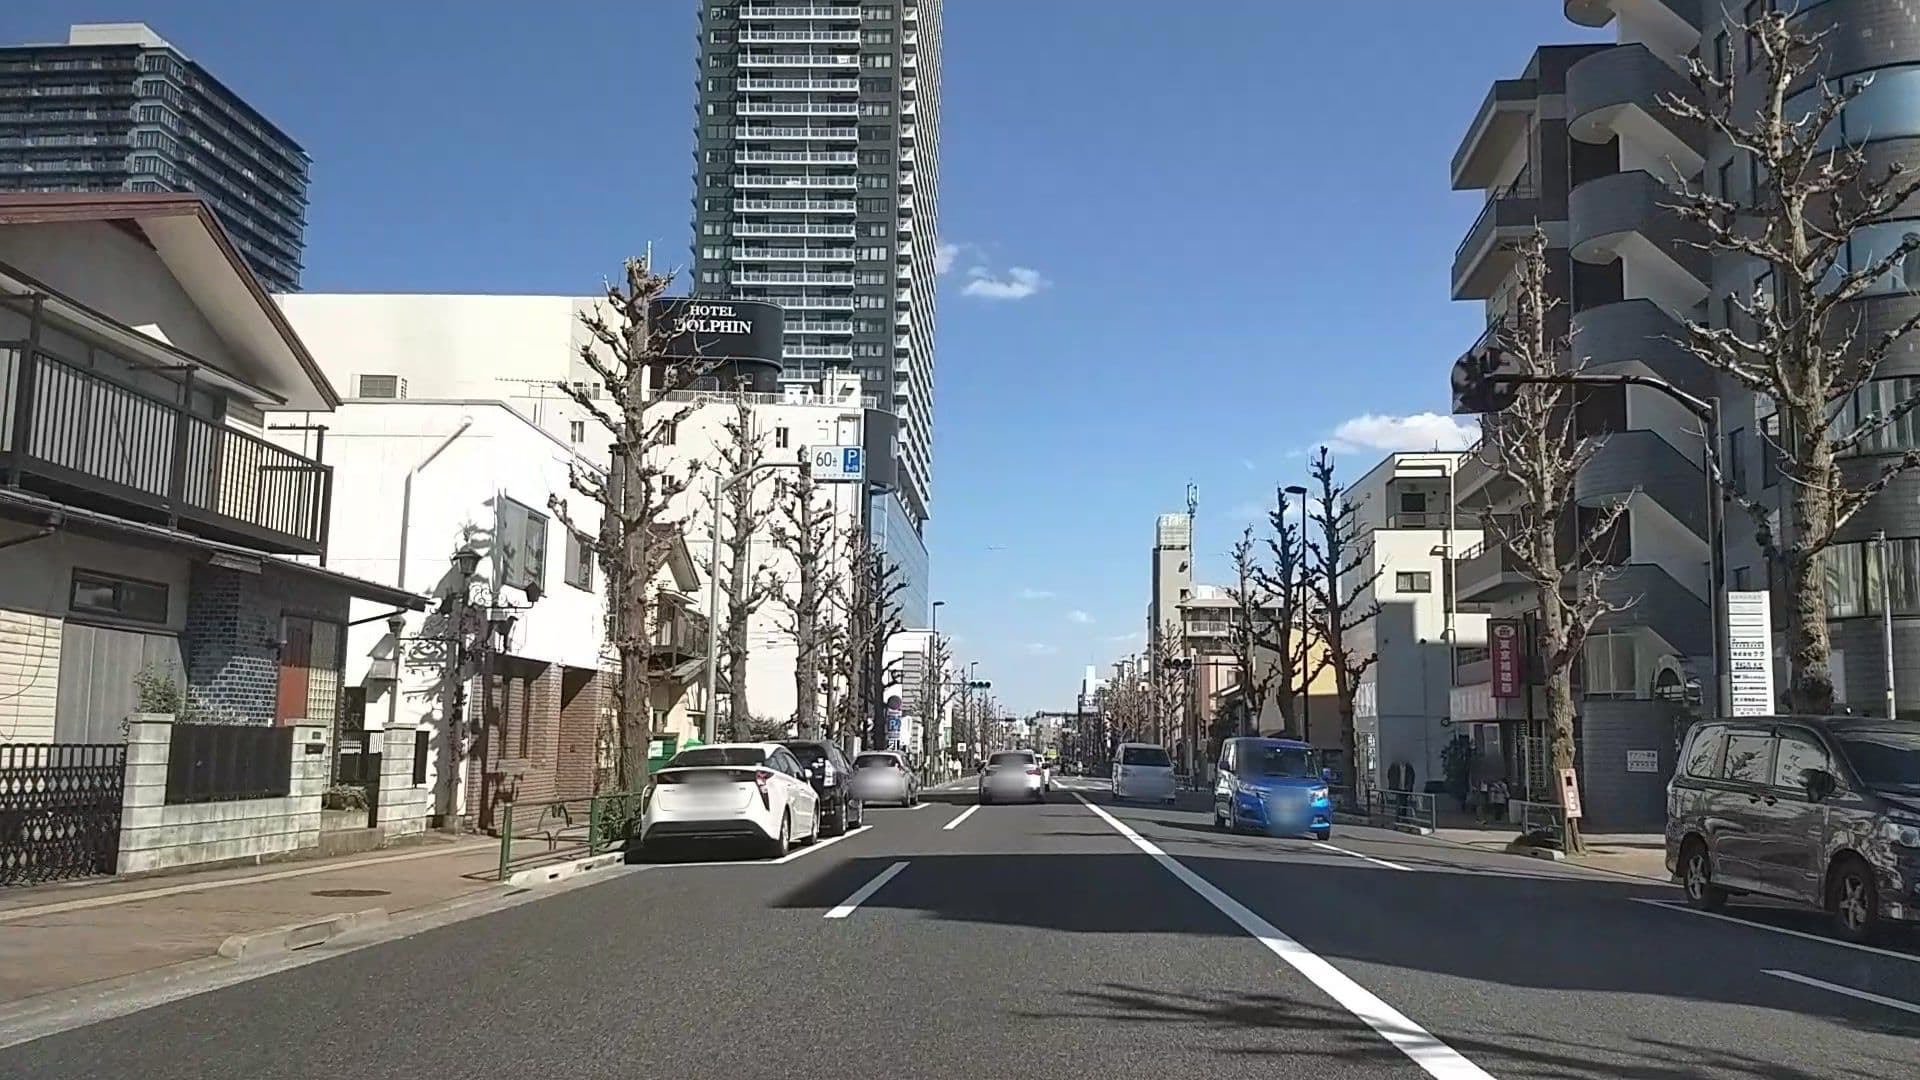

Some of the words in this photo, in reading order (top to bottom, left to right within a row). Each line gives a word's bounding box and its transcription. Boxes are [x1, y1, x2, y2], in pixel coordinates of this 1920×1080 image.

[690, 305, 737, 317] HOTEL
[673, 318, 753, 335] DOLPHIN
[847, 449, 858, 465] P
